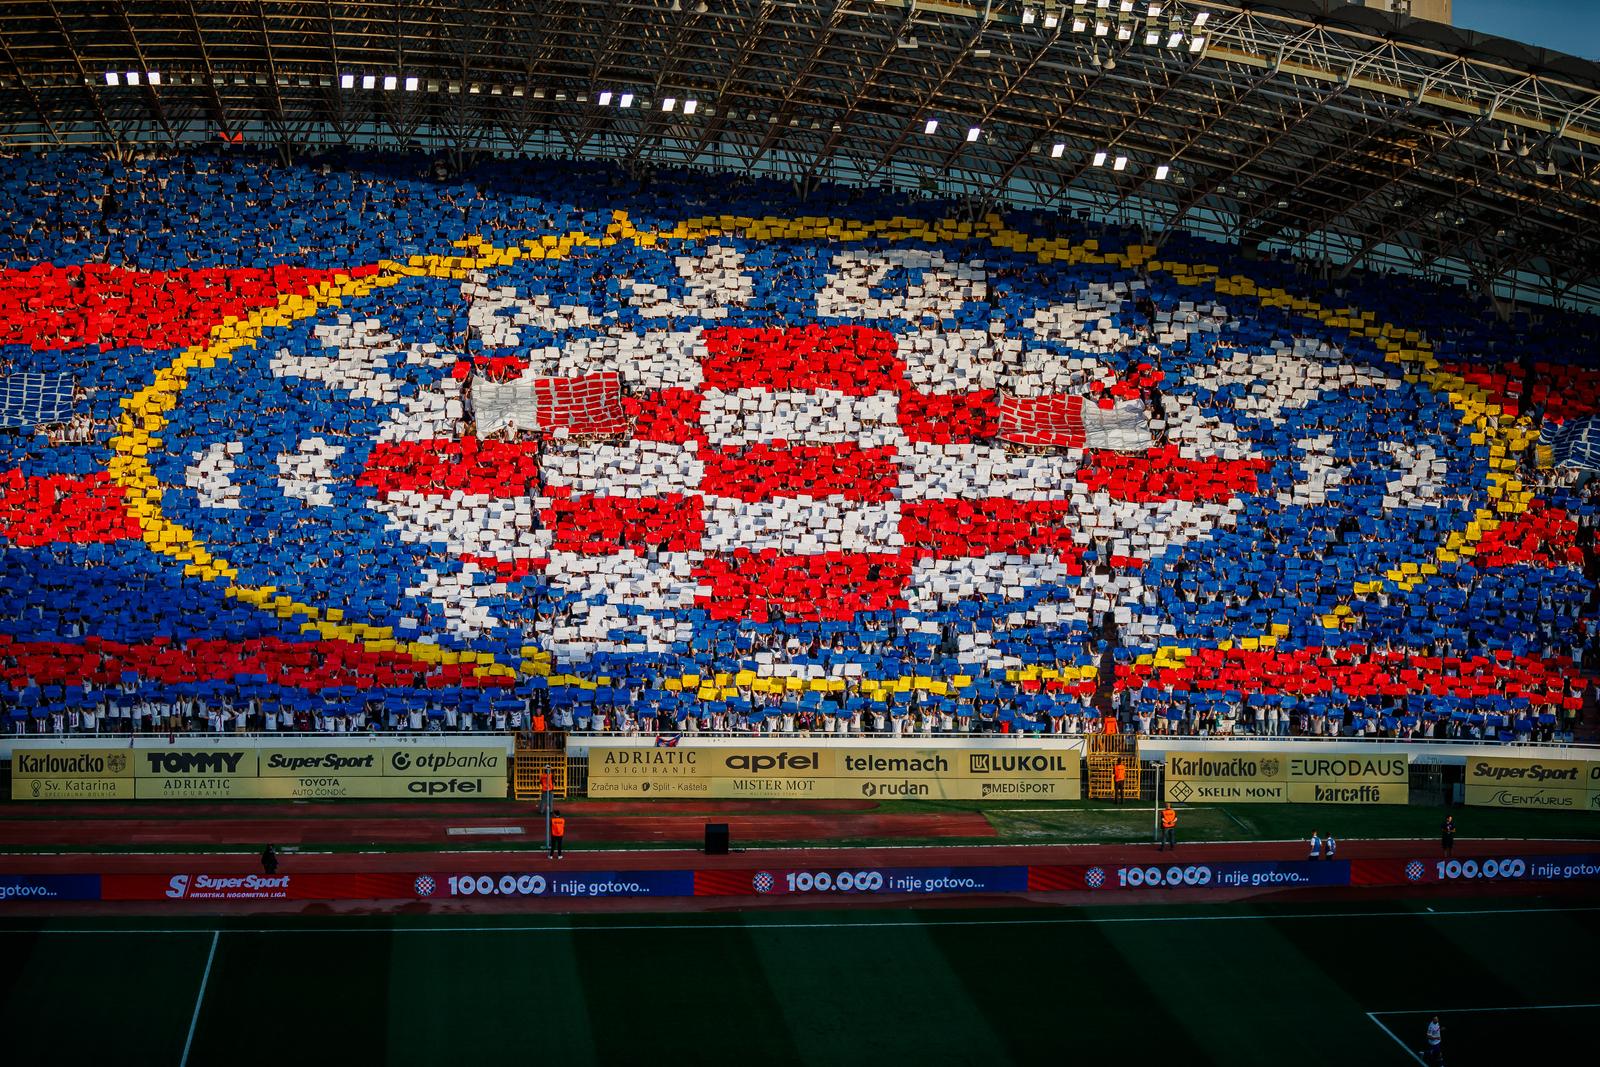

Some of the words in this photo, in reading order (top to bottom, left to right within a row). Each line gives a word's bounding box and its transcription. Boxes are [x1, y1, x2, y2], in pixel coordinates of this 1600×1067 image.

[19, 753, 104, 773] Karlovačko
[147, 752, 245, 773] TOMMY
[267, 753, 374, 771] SuperSport
[416, 752, 498, 772] otpbanka
[604, 751, 697, 764] ADRIATIC
[725, 752, 819, 773] apfel
[845, 755, 948, 772] telemach
[992, 755, 1067, 772] LUKOIL
[1171, 757, 1257, 777] Karlovačko
[1291, 759, 1404, 776] EURODAUS
[1473, 762, 1579, 781] SuperSport
[44, 780, 60, 791] Sv.
[65, 779, 116, 791] Katarina
[164, 779, 230, 789] ADRIATIC
[299, 779, 340, 787] TOYOTA
[408, 779, 482, 795] apfel
[591, 782, 619, 791] Zračna
[621, 782, 638, 791] luka
[653, 782, 670, 792] Split
[678, 782, 708, 791] Kaštela
[732, 779, 784, 791] MISTER
[786, 779, 816, 791] MOT
[880, 780, 929, 795] rudan
[992, 781, 1056, 793] MEDIŠPORT
[292, 788, 314, 796] AUTO
[1198, 786, 1241, 797] SKELIN
[1245, 786, 1282, 797] MONT
[1315, 784, 1380, 802] barcaffé
[1217, 870, 1221, 883] i
[1225, 870, 1249, 885] nije
[1252, 871, 1309, 886] gotovo...
[1531, 864, 1535, 876] i
[1538, 863, 1561, 879] nije
[194, 875, 290, 890] SuperSport
[552, 880, 556, 893] i
[560, 880, 586, 895] nije
[589, 880, 650, 896] gotovo...
[889, 876, 893, 889] i
[897, 876, 922, 891] nije
[925, 876, 985, 892] gotovo...
